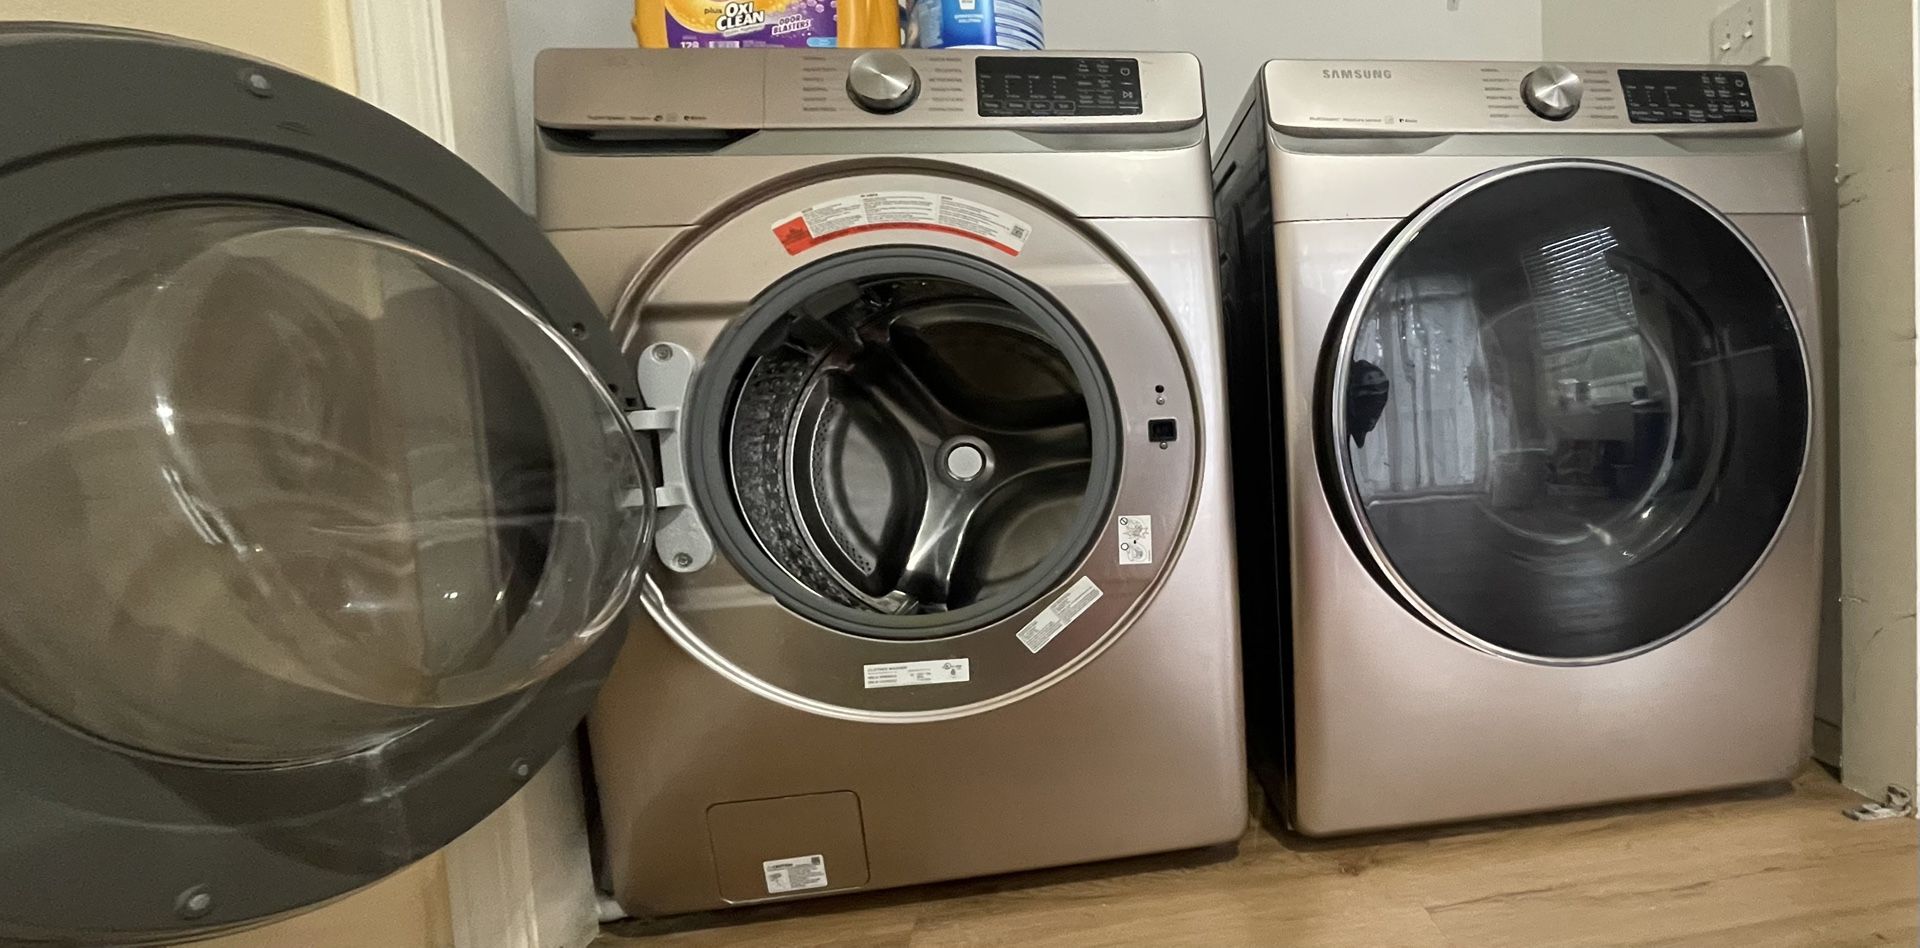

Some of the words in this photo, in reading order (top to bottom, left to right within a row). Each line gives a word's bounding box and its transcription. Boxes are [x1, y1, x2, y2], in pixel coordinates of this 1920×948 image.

[704, 6, 722, 15] plus
[726, 2, 753, 17] OXI
[716, 10, 764, 31] CLEAN
[779, 14, 801, 25] ODOR
[772, 20, 810, 34] BLASTERS
[1322, 69, 1392, 79] SAMSUNG
